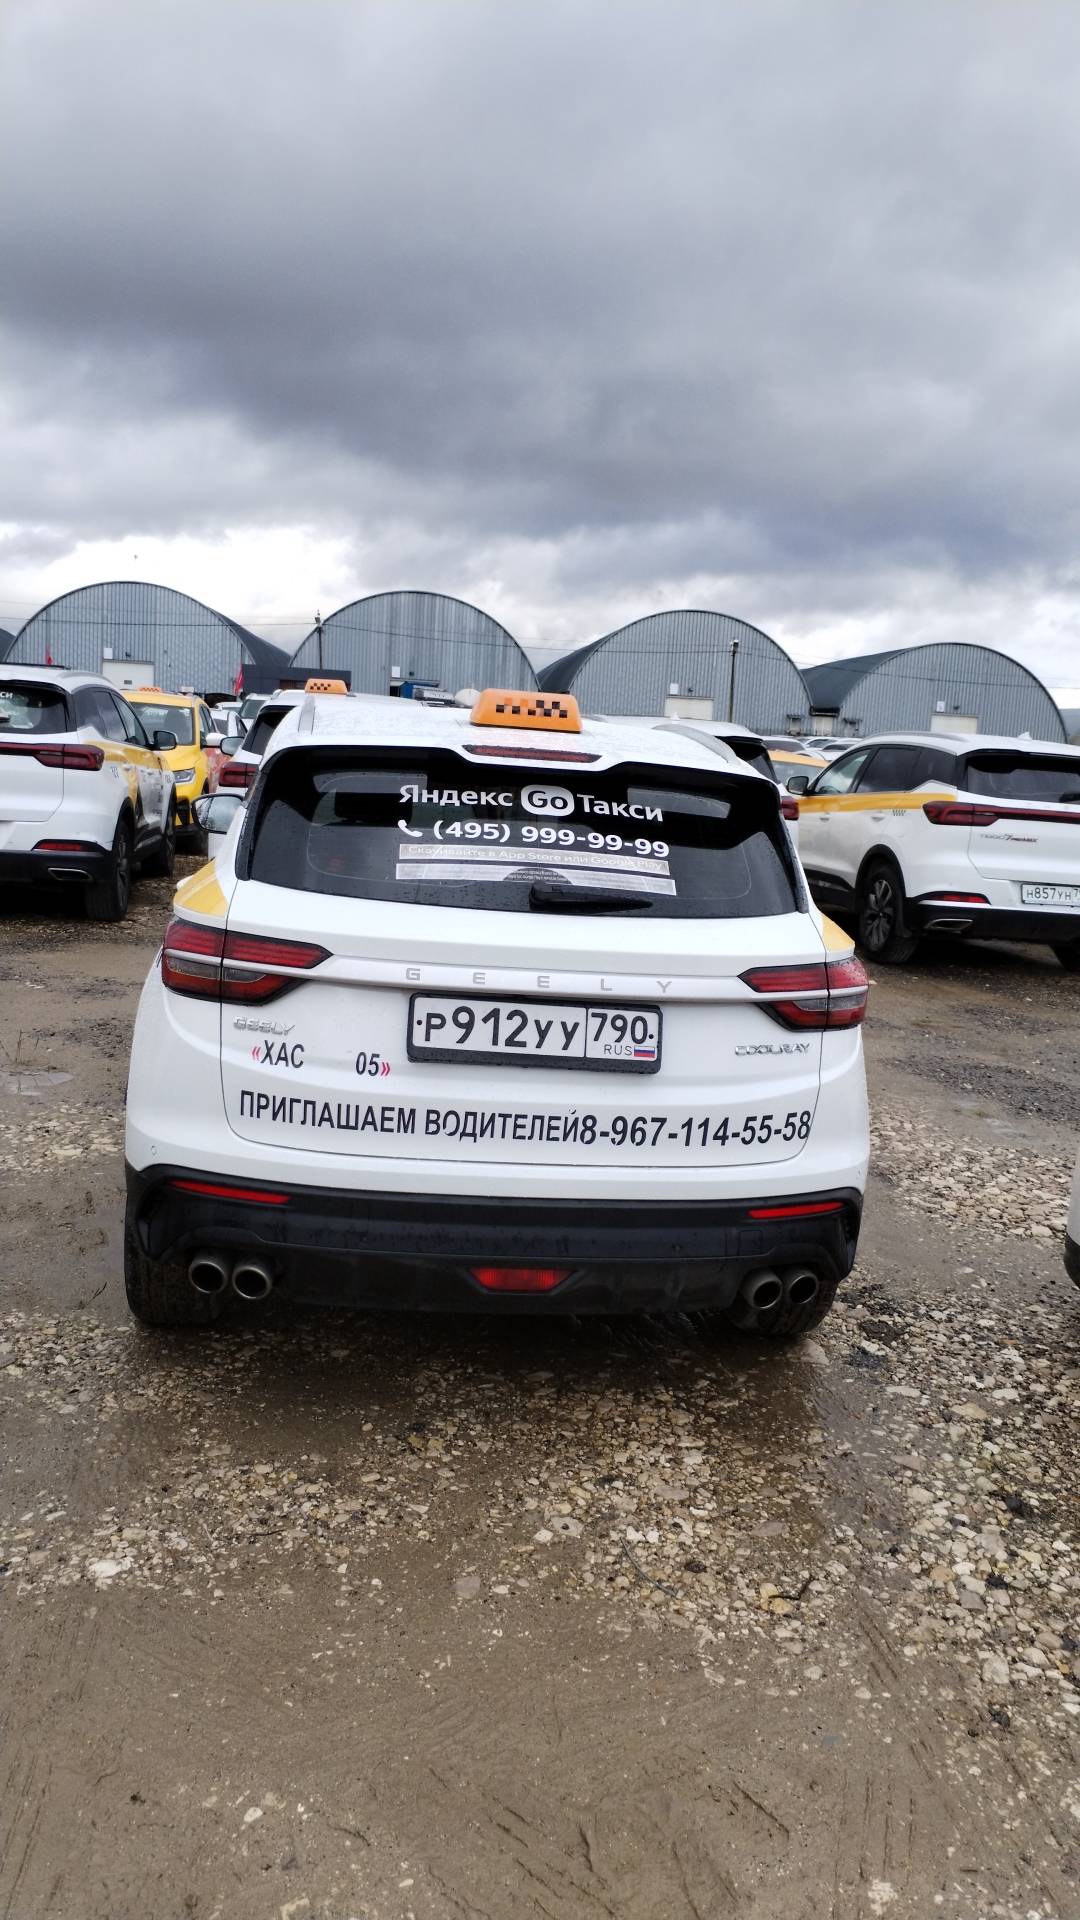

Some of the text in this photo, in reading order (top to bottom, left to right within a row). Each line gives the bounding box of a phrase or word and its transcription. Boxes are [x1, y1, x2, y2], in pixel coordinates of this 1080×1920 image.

[399, 784, 664, 823] Яндекс Go Такси
[433, 820, 670, 858] (495) 999-99-99
[499, 850, 526, 861] App
[406, 967, 672, 994] GEELY
[590, 1011, 648, 1045] 790
[603, 1044, 632, 1056] RUS
[240, 1090, 416, 1134] ПРИГЛАШАЕМ
